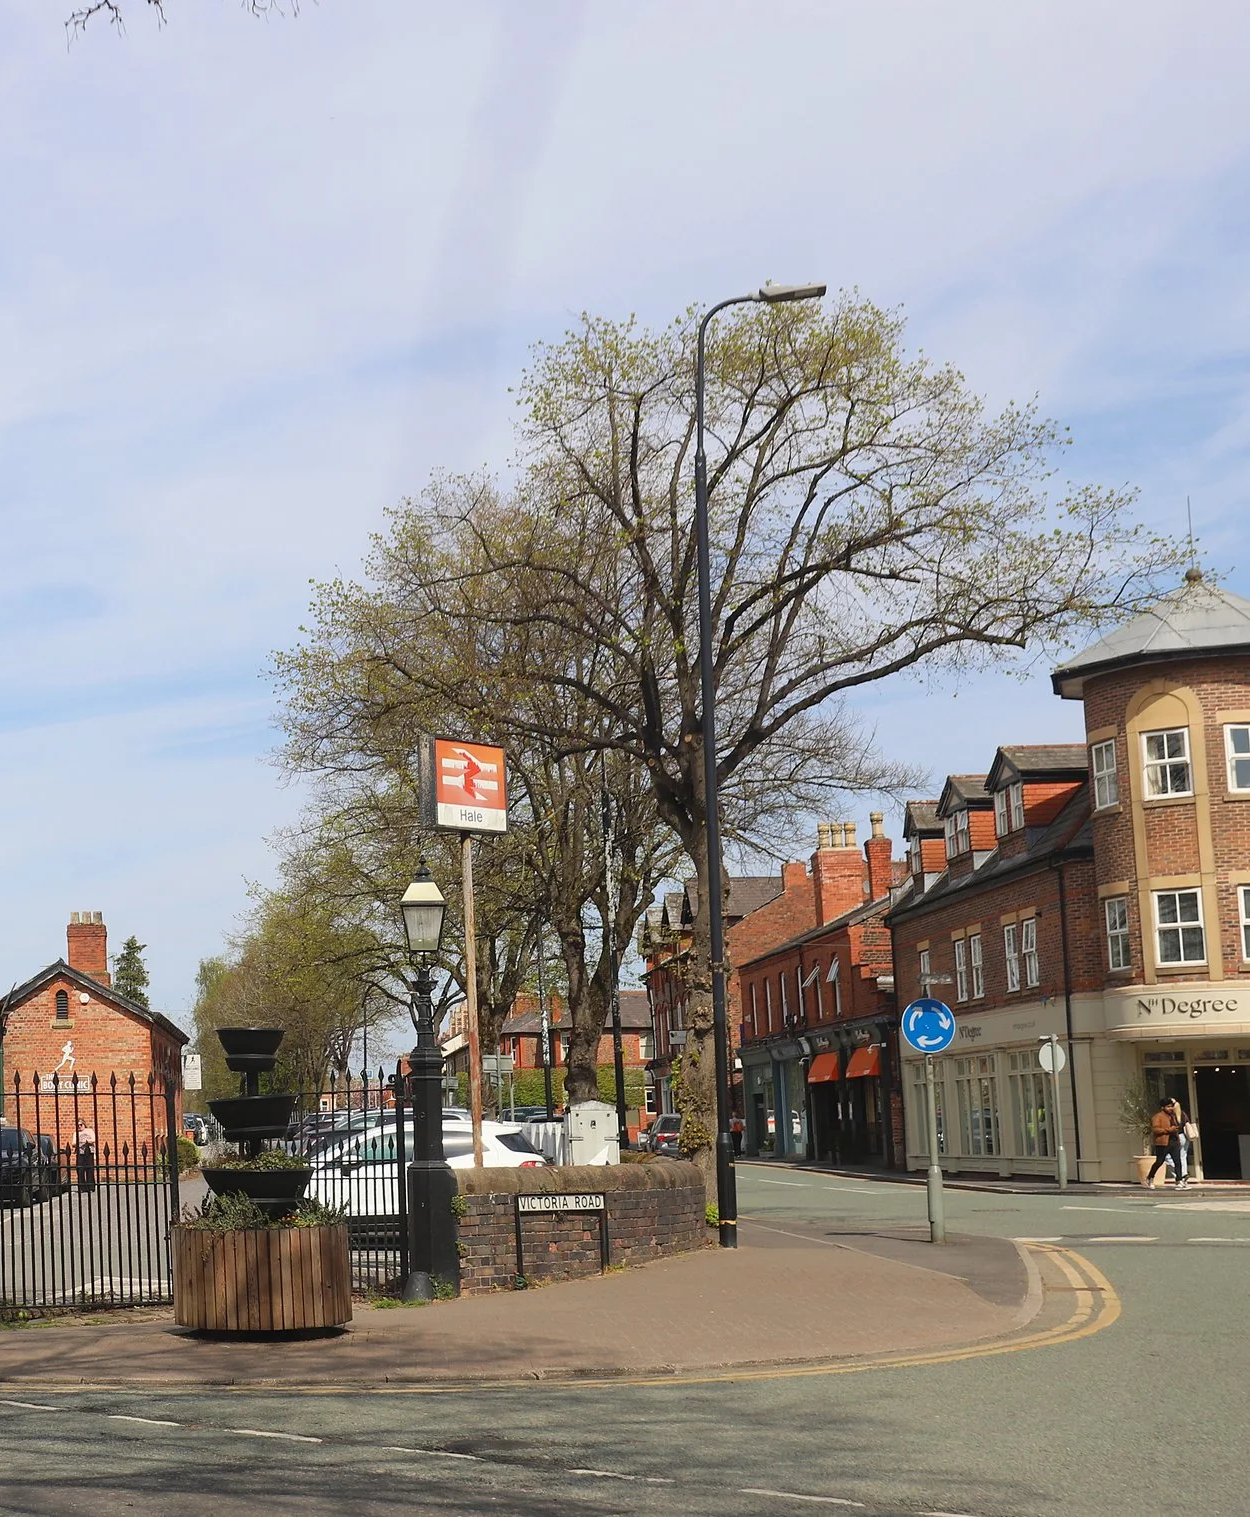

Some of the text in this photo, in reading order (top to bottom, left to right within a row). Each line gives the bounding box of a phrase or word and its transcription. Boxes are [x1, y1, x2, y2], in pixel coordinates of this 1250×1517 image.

[460, 809, 483, 822] Hale
[1162, 998, 1239, 1019] Degree
[43, 1080, 63, 1090] BOY
[519, 1195, 602, 1210] VICTORIA ROAD
